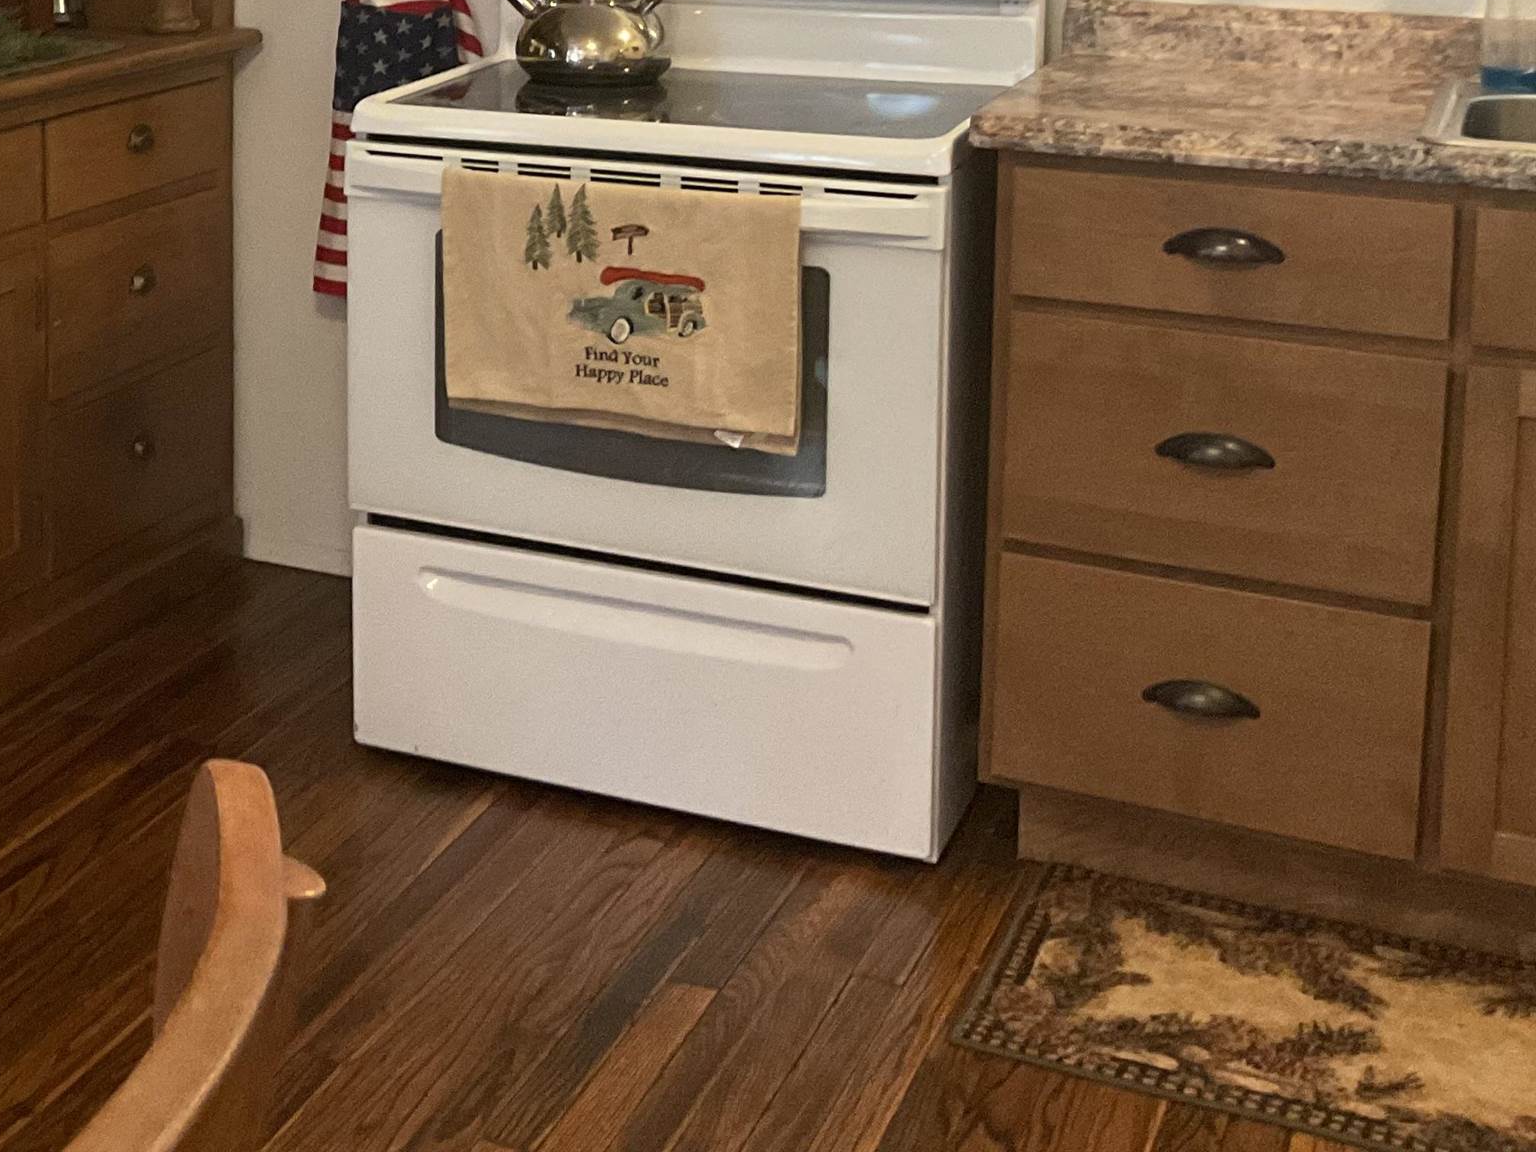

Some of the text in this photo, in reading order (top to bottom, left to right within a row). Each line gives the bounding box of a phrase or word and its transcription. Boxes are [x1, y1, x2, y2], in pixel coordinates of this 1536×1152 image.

[584, 346, 660, 368] Find Your
[575, 364, 669, 388] Happy Place
